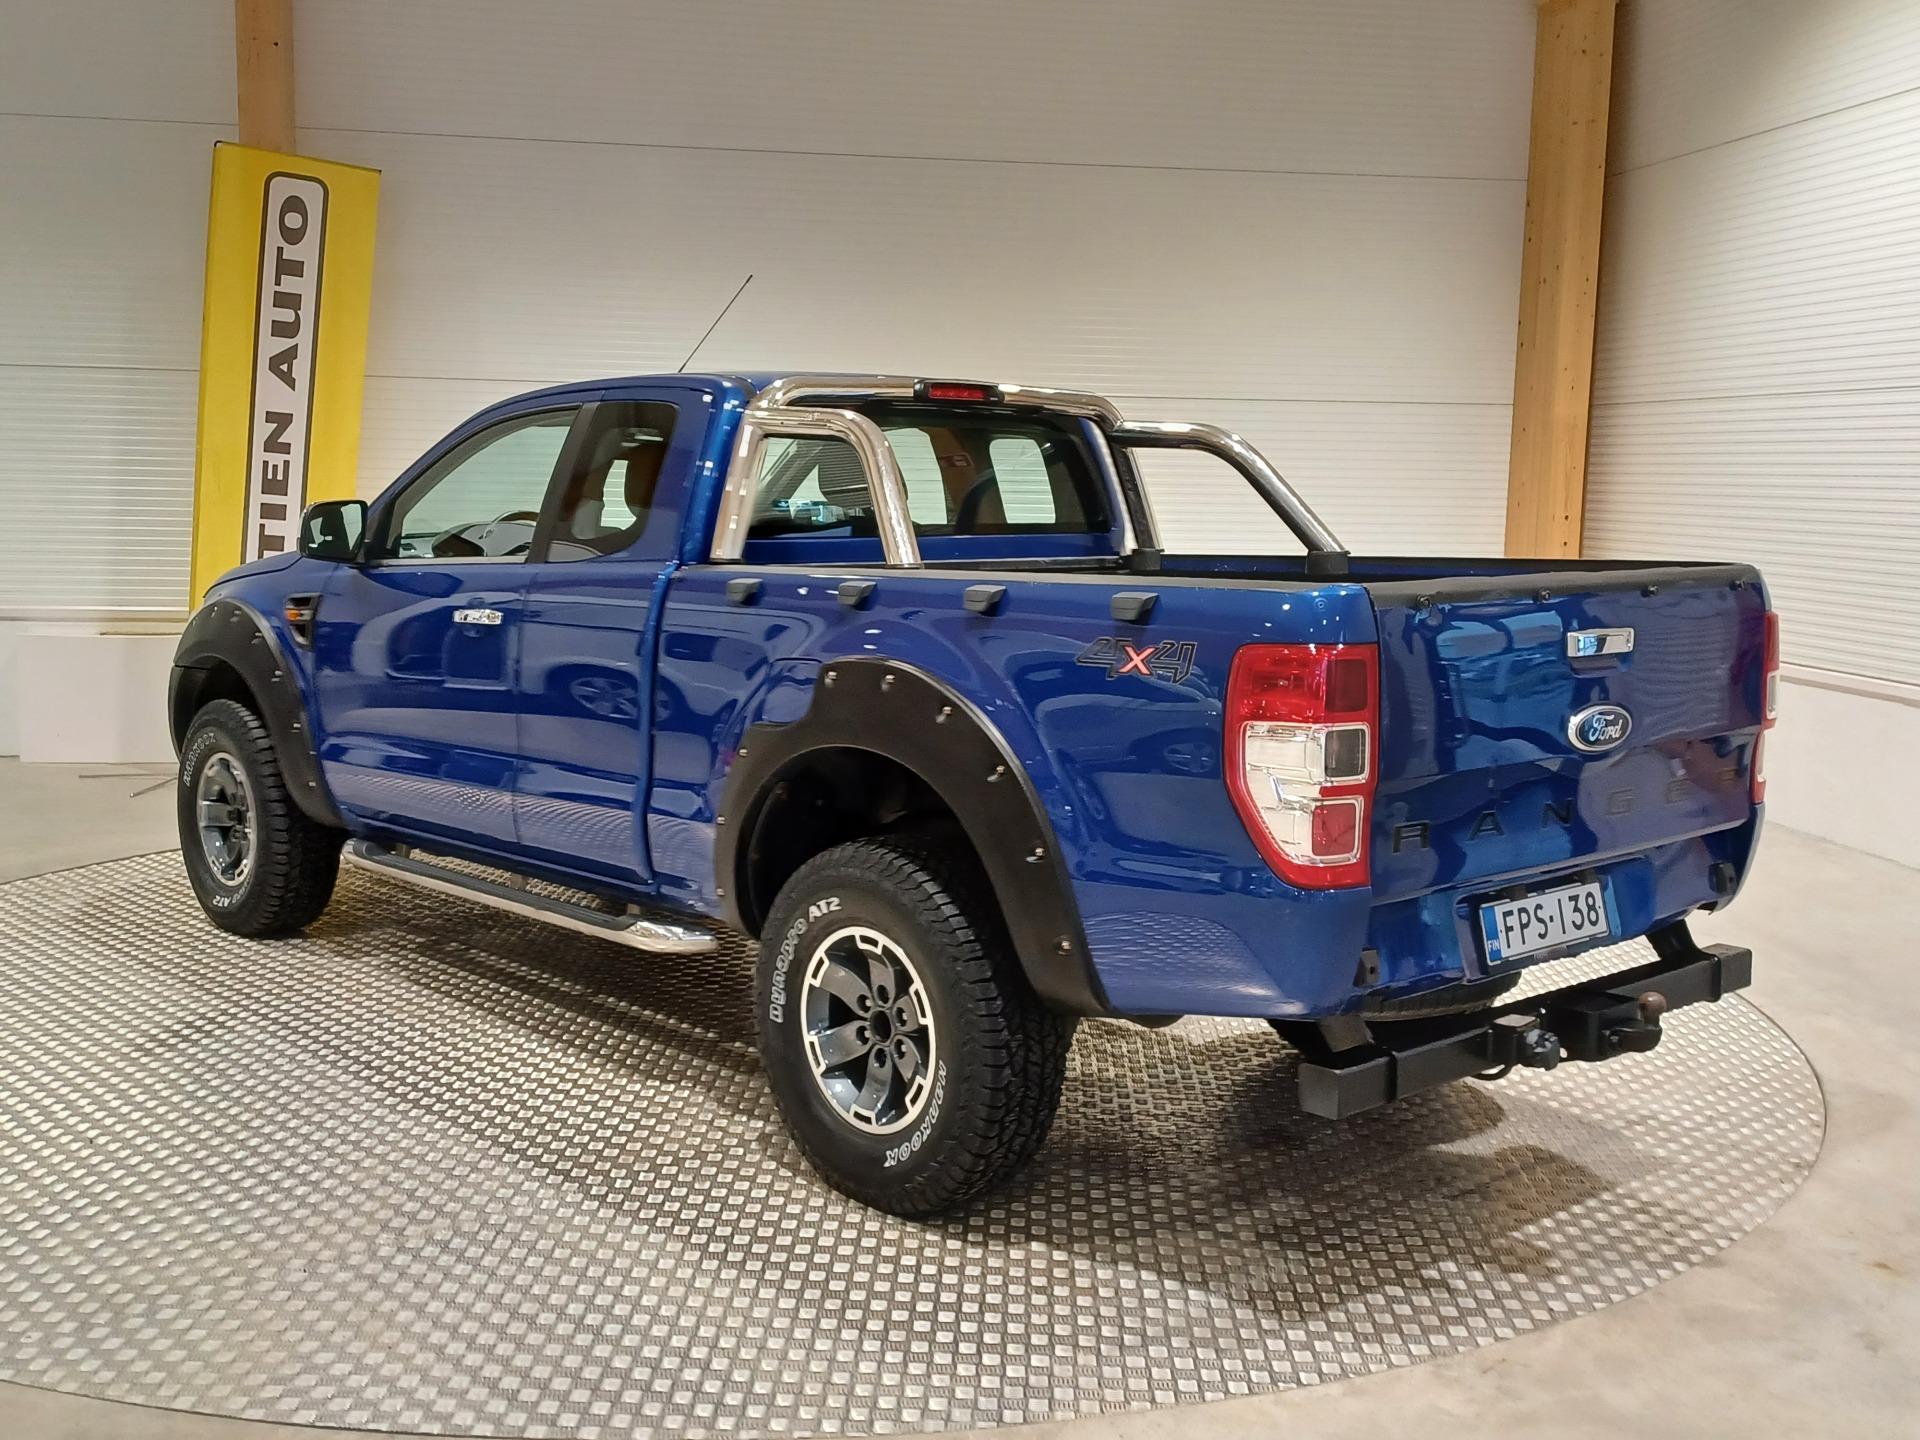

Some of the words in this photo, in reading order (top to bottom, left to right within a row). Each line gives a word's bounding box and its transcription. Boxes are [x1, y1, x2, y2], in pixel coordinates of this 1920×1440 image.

[269, 194, 309, 392] AUTO
[1588, 714, 1623, 742] Ford
[808, 897, 842, 923] AT2
[1502, 891, 1600, 949] FPS-138
[1488, 939, 1500, 953] FIN
